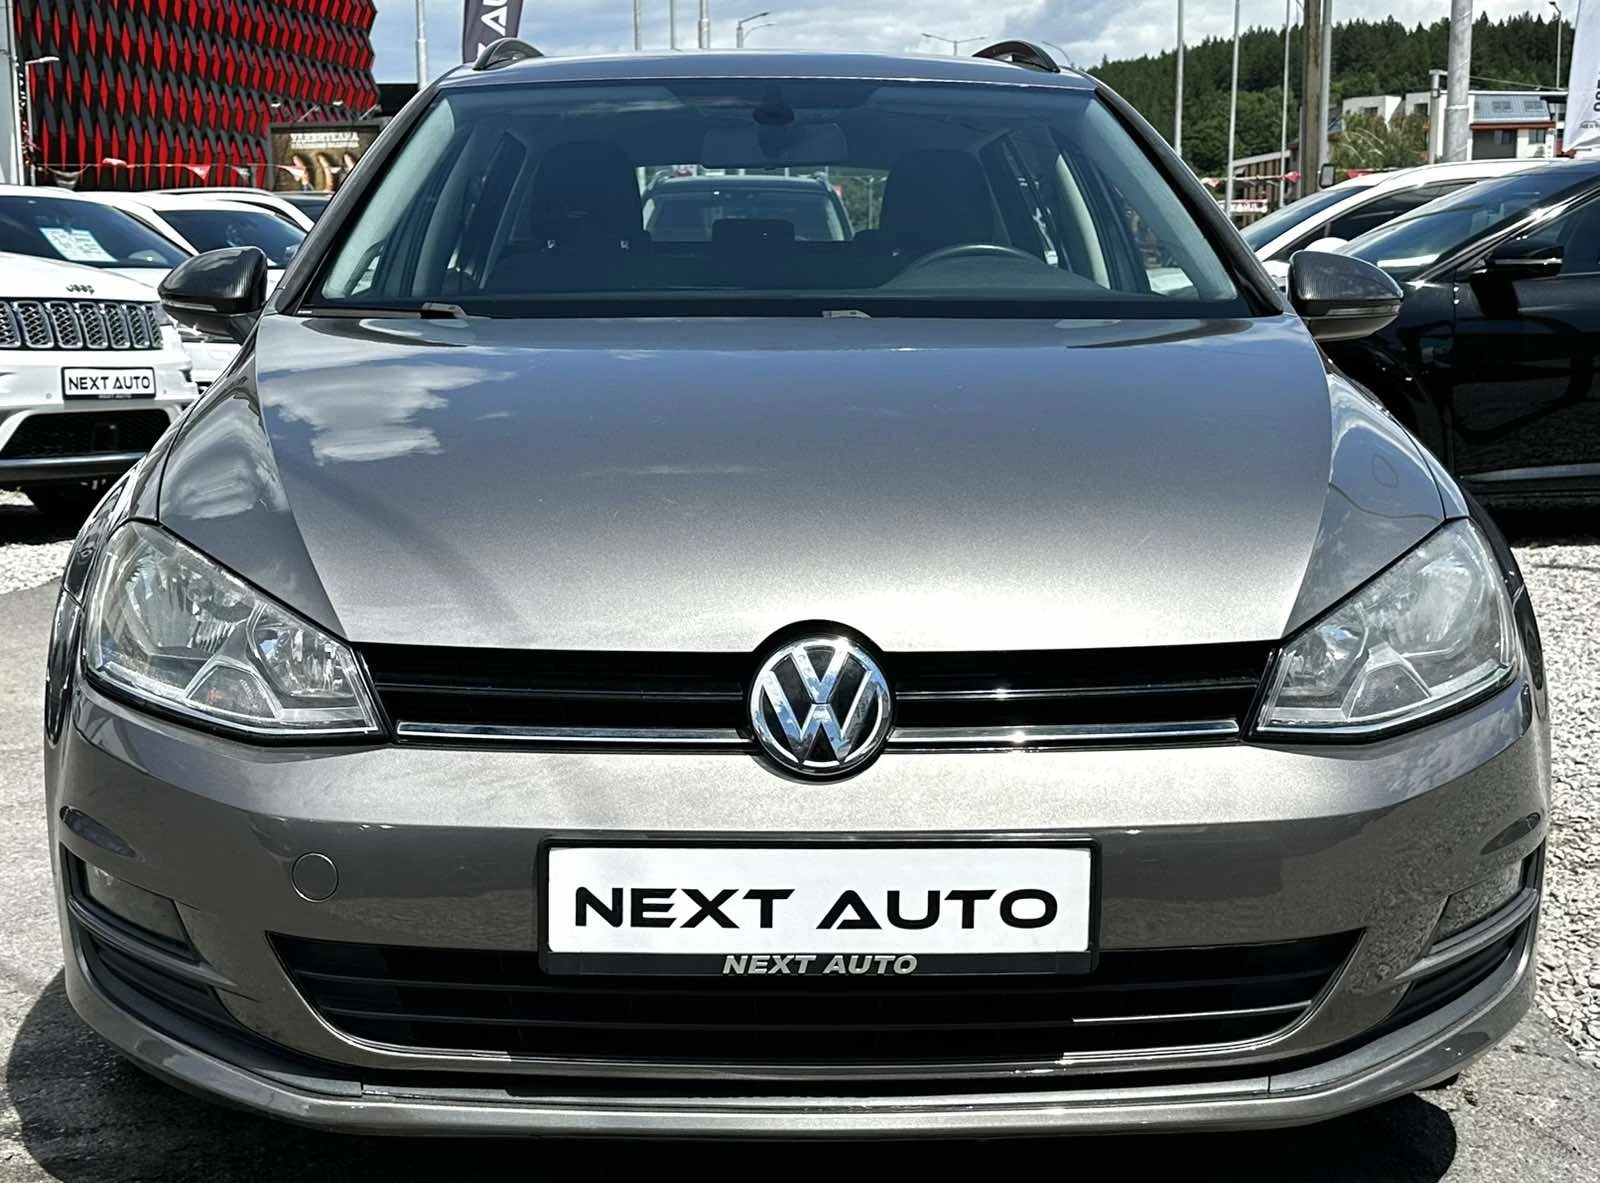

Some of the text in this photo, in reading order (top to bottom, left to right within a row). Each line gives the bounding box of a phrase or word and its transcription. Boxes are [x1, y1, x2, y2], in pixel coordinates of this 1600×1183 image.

[69, 376, 150, 390] NEXT AUTO
[576, 887, 1057, 929] NEXT AUTO
[723, 955, 917, 974] NEXT AUTO
